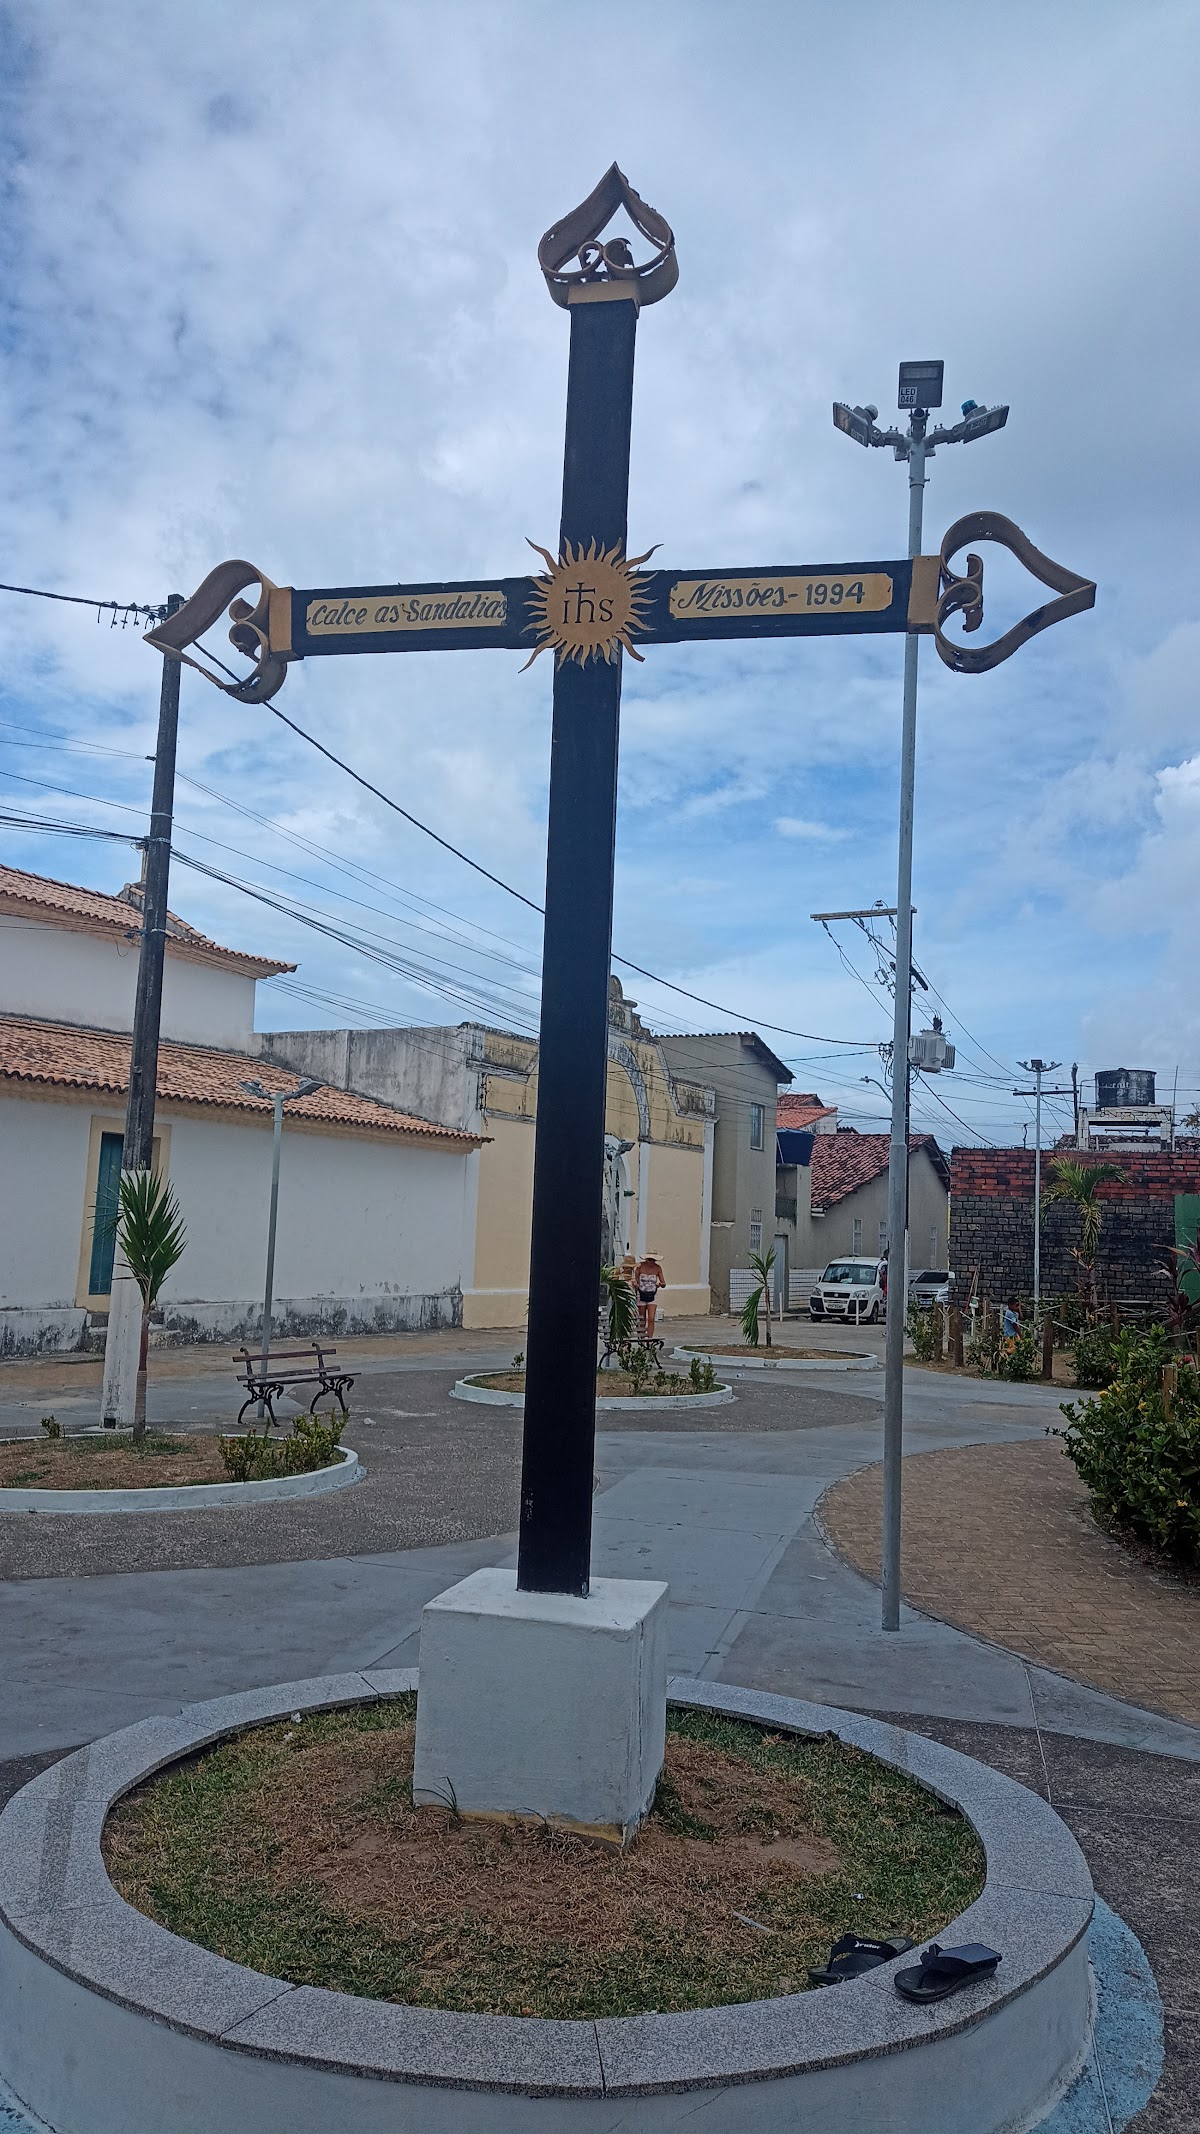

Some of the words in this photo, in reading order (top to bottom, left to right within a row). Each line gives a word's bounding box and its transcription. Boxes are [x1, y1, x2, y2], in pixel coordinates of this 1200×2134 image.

[805, 581, 865, 606] 1994
[311, 600, 368, 626] Calce
[374, 604, 400, 624] as
[406, 594, 506, 623] Sandalias
